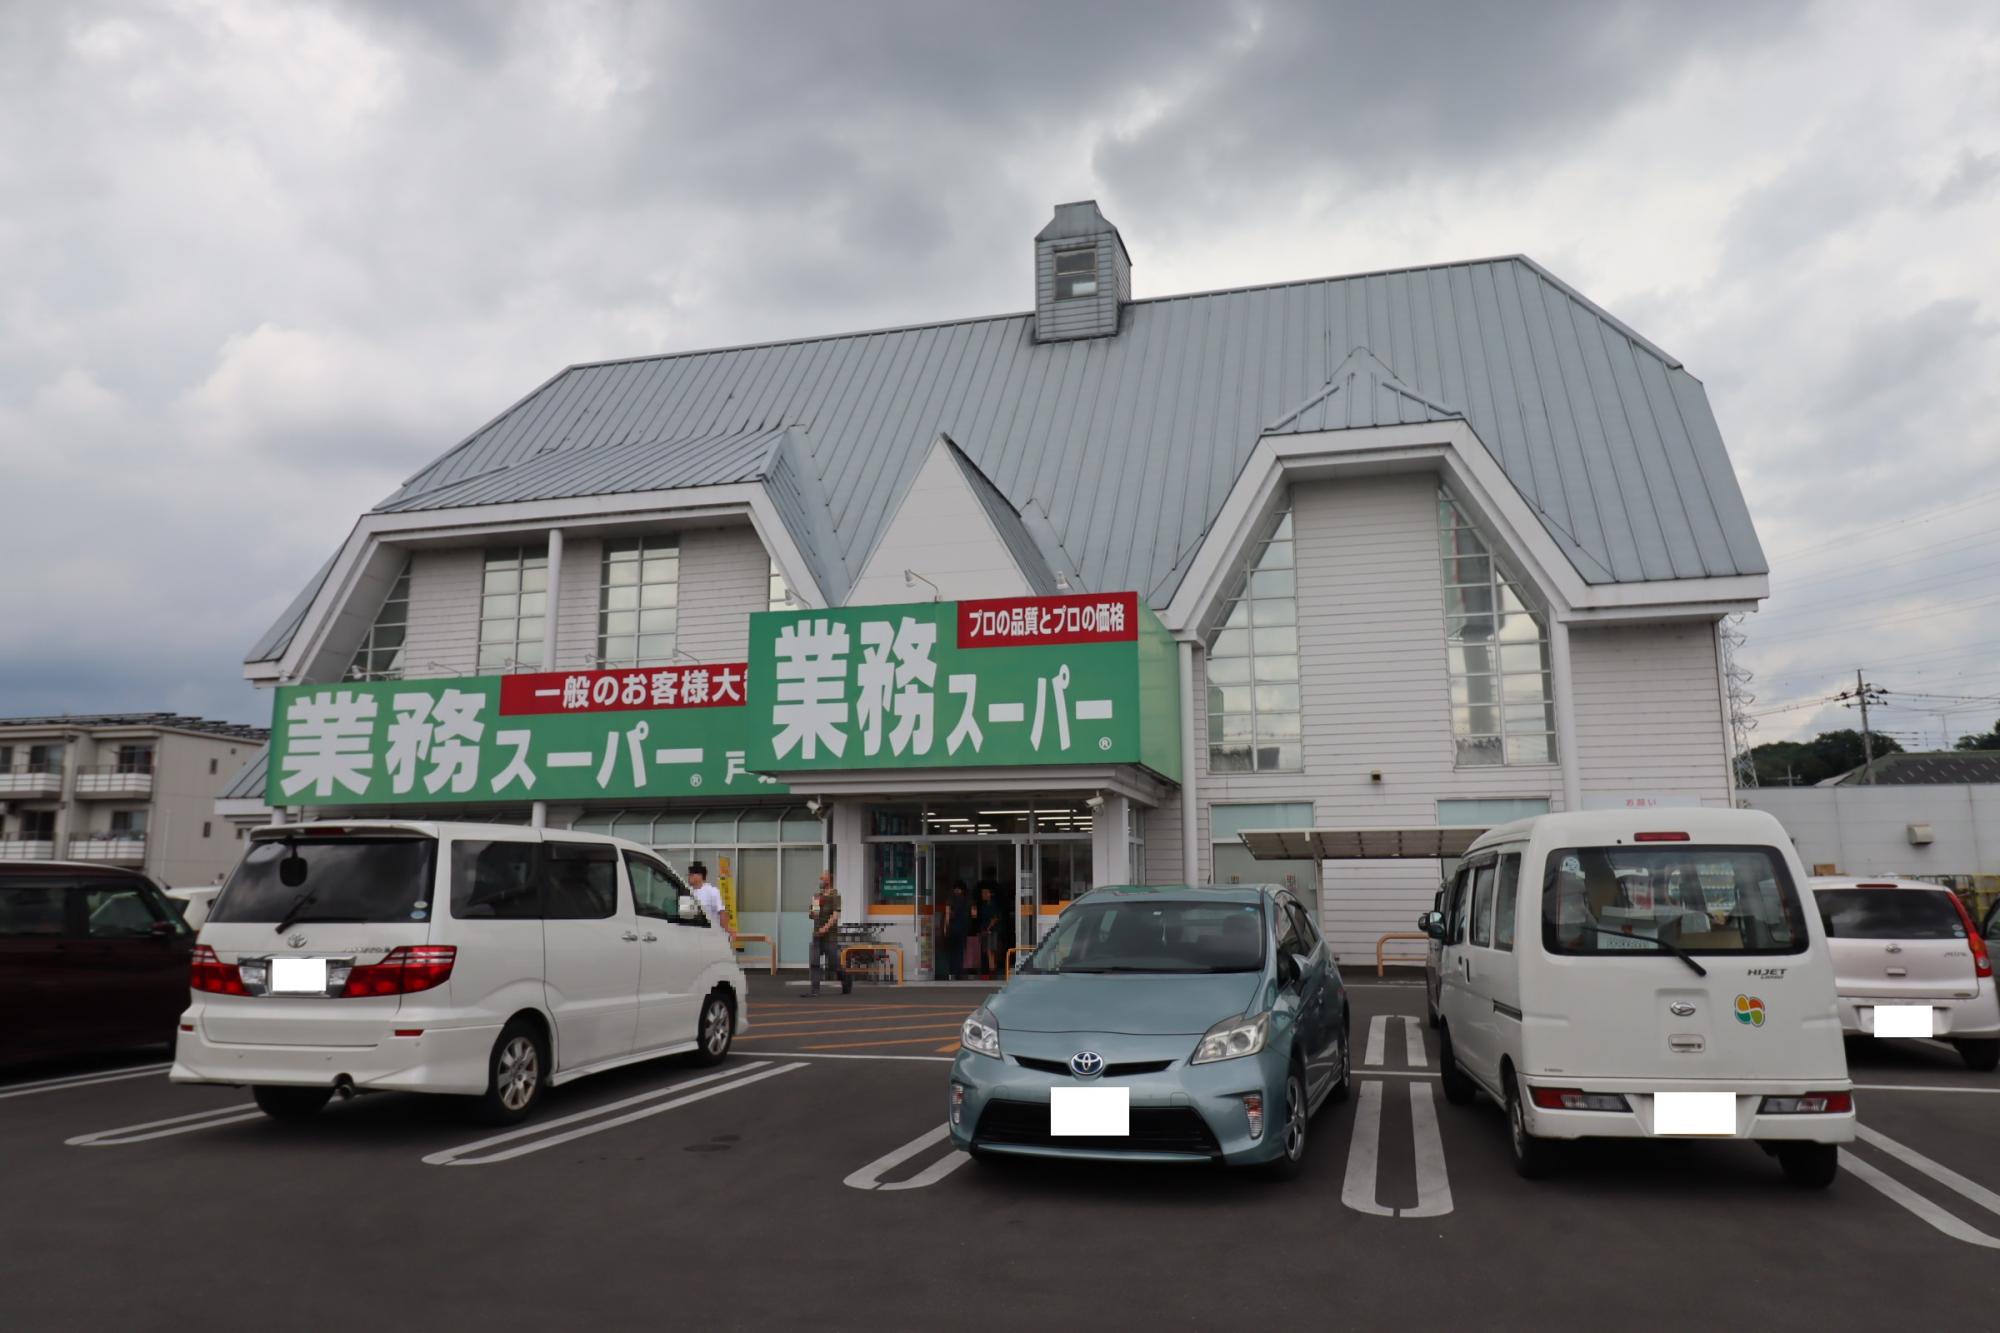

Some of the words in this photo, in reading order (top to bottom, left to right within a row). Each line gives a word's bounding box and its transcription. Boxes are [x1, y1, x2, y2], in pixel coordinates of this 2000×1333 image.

[968, 602, 1125, 639] プロの品質とプロの価格
[534, 666, 748, 709] 一般のお客様大
[771, 616, 1113, 760] 業務スーパー
[280, 688, 704, 797] 業務スーパー
[1747, 968, 1788, 976] HIJET
